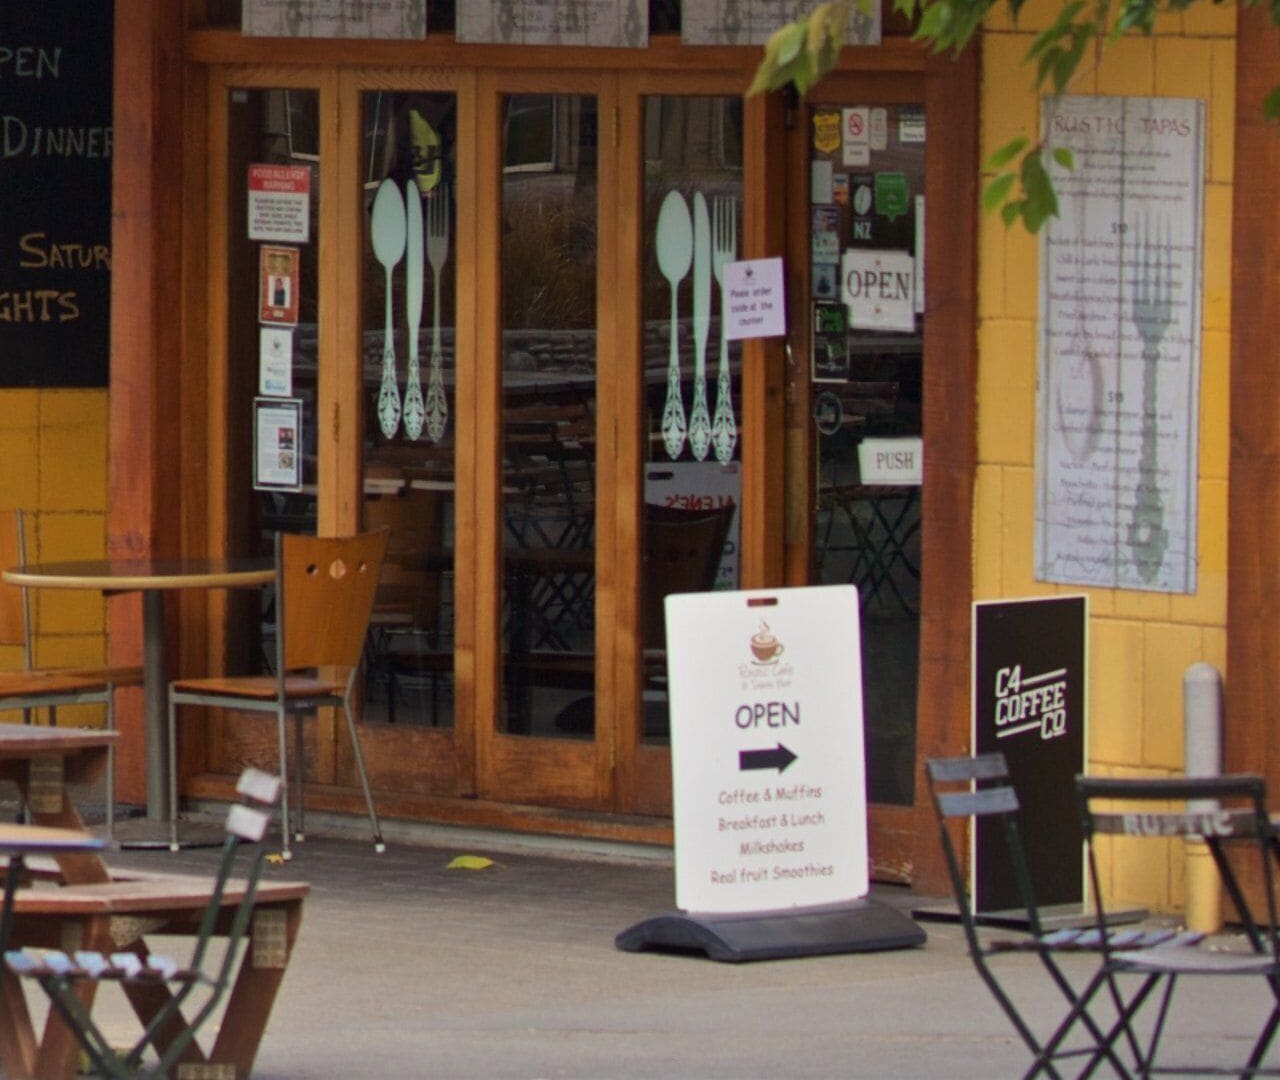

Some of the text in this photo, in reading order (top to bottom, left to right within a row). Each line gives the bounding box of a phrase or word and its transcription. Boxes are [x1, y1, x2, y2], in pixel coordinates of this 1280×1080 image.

[1053, 116, 1191, 137] RUSTIC TAPAS
[853, 221, 872, 240] NZ
[847, 269, 909, 300] OPEN
[876, 451, 914, 470] PUSH
[995, 665, 1021, 700] C4
[995, 681, 1067, 725] COFFEE
[734, 700, 801, 731] OPEN
[1040, 710, 1067, 741] CO
[718, 784, 823, 807] Coffee & Muffins
[718, 811, 826, 833] Breakfast & Lunch
[739, 838, 805, 858] Milkshakes
[710, 863, 834, 886] Real fruit Smoothies
